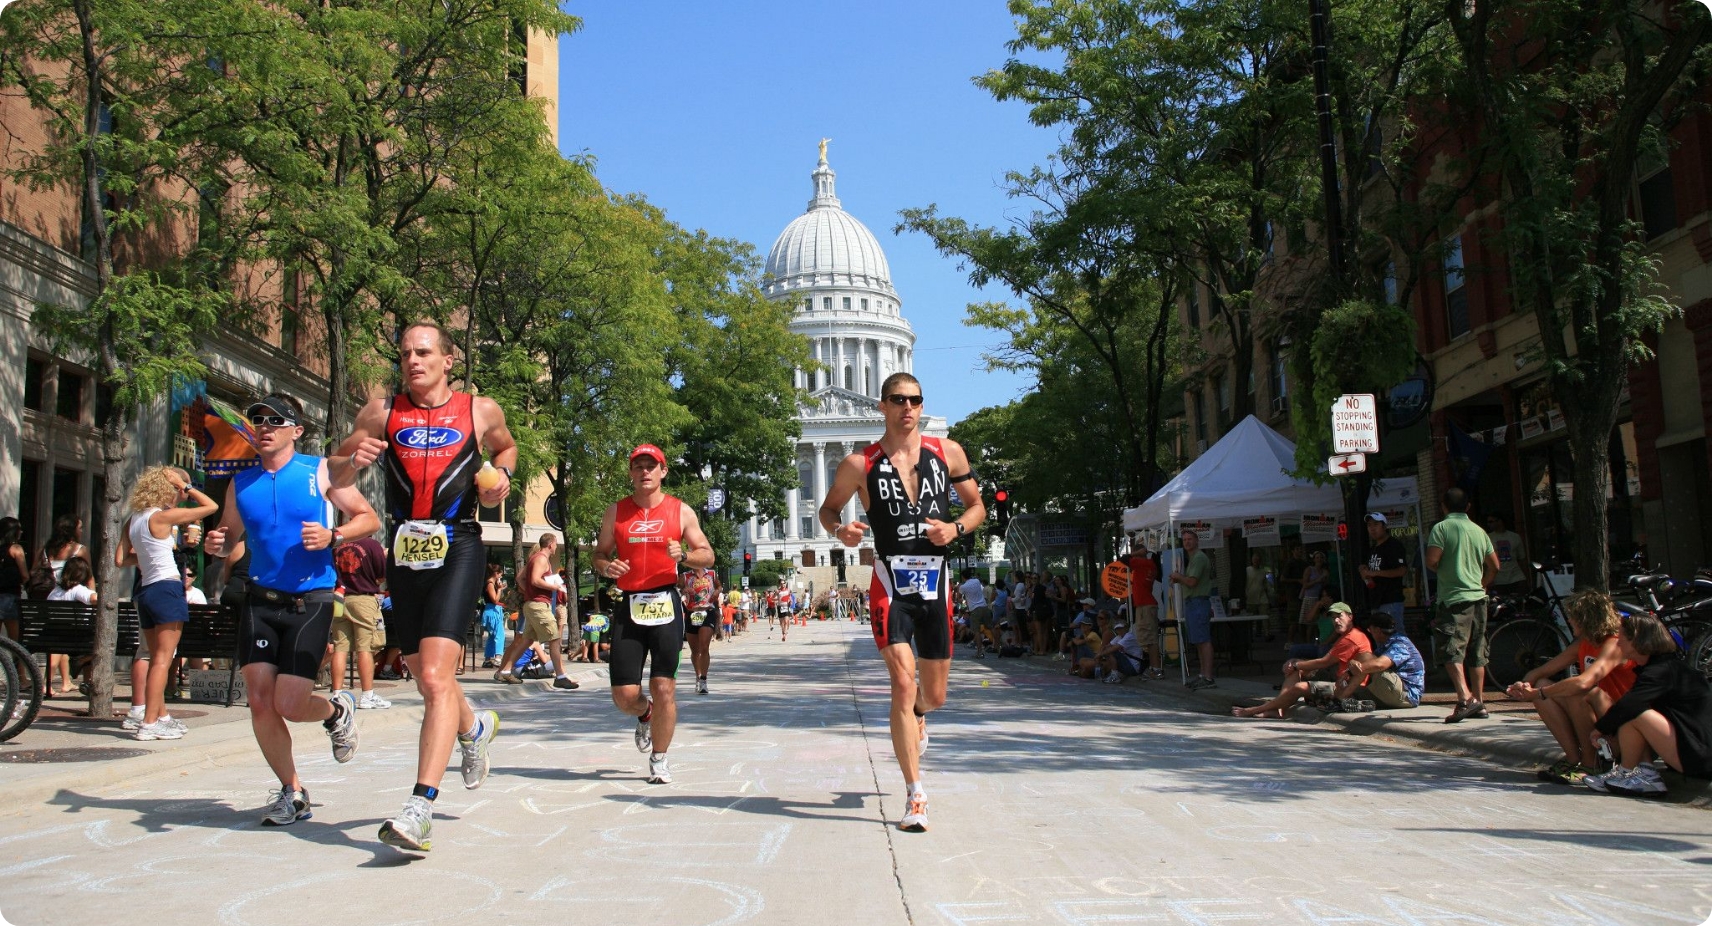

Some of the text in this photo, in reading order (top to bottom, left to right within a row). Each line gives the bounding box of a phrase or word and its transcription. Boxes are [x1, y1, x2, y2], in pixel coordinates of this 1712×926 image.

[1346, 398, 1360, 410] NO
[1336, 412, 1372, 420] STOPPING
[1336, 422, 1374, 432] STANDING
[408, 429, 448, 445] Ford
[1340, 439, 1372, 448] PARKING
[402, 450, 453, 458] ZORREL
[402, 536, 444, 554] 1229
[402, 552, 442, 562] HENSEL
[908, 570, 928, 588] 25
